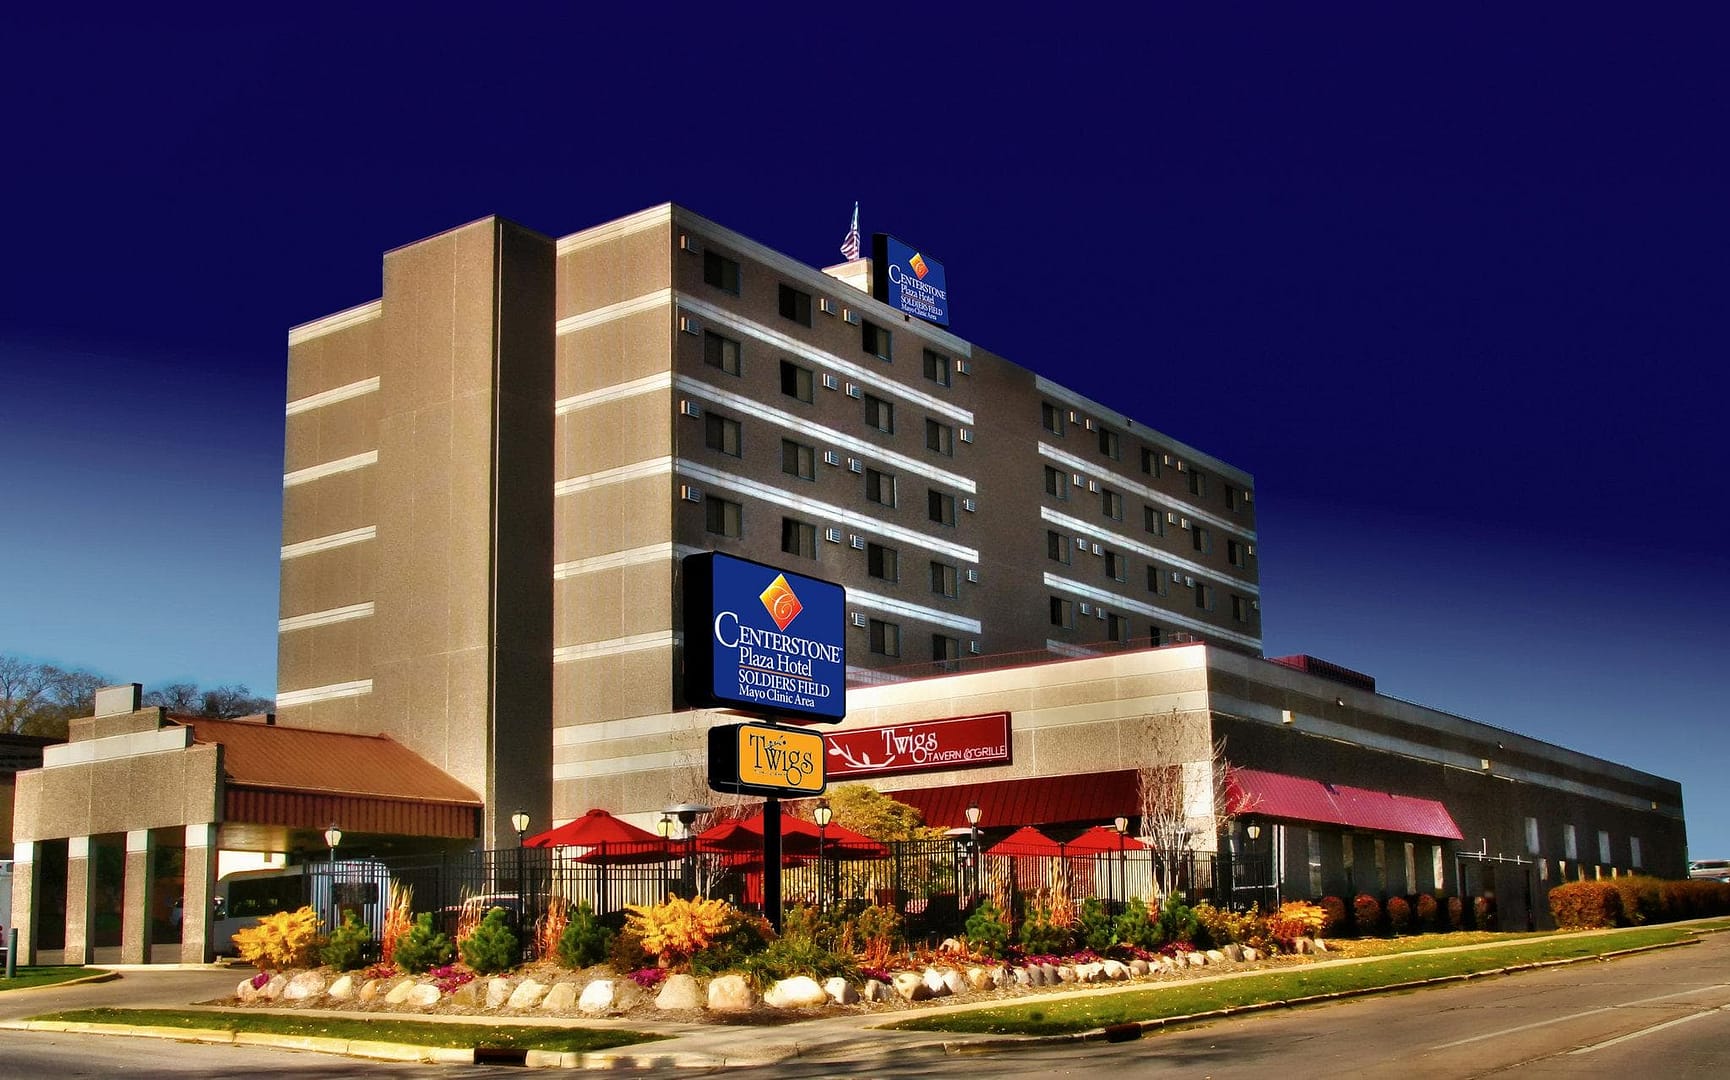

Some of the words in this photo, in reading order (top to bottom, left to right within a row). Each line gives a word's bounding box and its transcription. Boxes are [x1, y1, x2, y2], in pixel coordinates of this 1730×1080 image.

[889, 265, 946, 300] CENTERSTONE
[901, 296, 929, 311] SOLDIERS
[928, 304, 942, 316] FIELD
[715, 612, 840, 663] CENTERSTONE
[739, 647, 773, 669] Plaza
[777, 654, 812, 677] Hotel
[739, 670, 796, 692] SOLDIERS
[798, 680, 830, 698] FIELD
[739, 685, 766, 701] Mayo
[767, 689, 793, 704] Clinic
[794, 696, 815, 707] Area
[750, 734, 813, 785] Twigs
[882, 728, 937, 763] Twigs
[928, 751, 961, 762] TAVERN
[976, 745, 1006, 757] GRILLE
